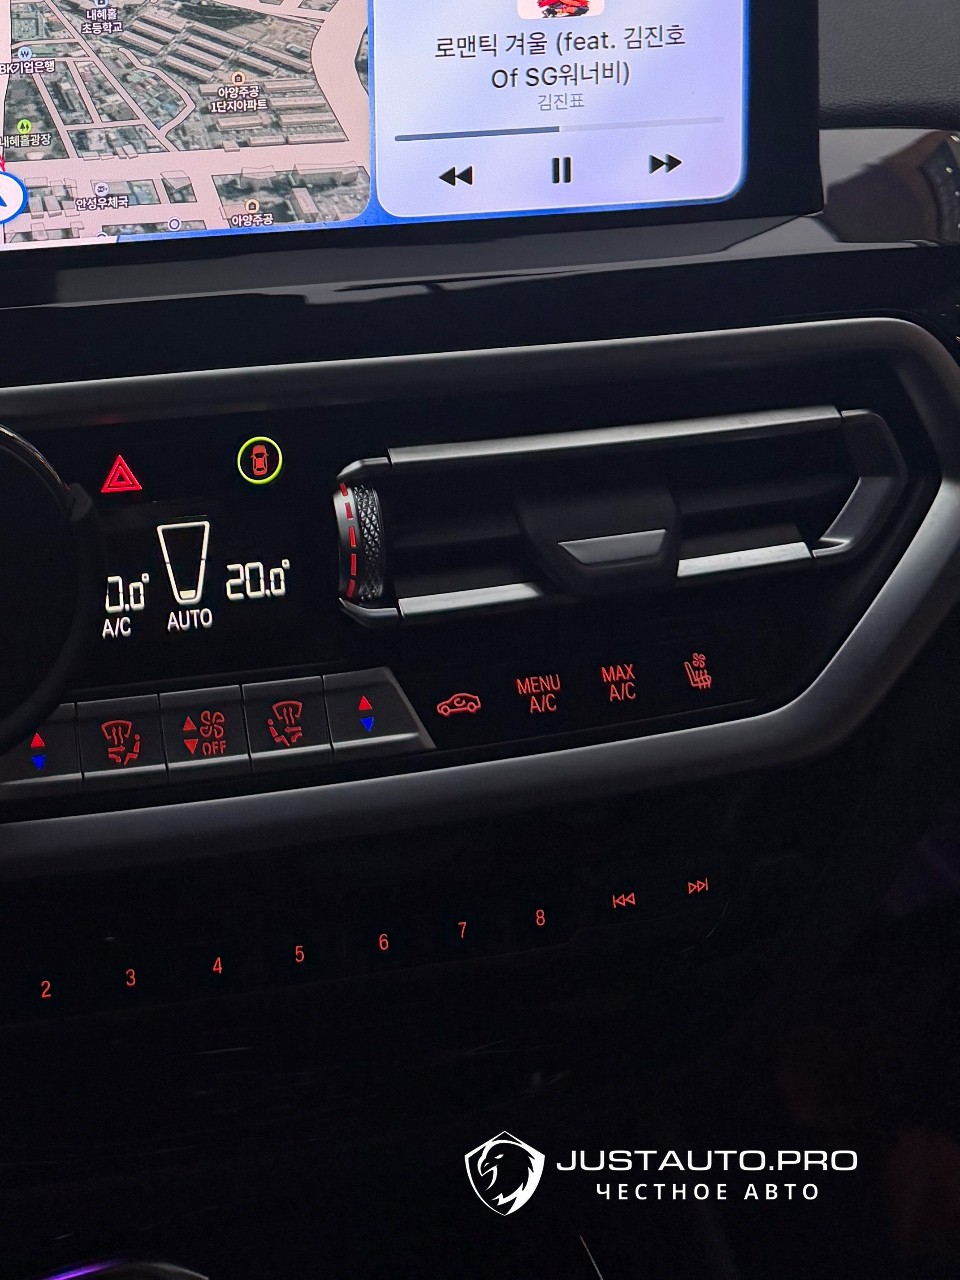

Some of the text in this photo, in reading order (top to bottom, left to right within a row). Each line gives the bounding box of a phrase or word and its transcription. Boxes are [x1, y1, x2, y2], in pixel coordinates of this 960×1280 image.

[82, 22, 123, 34] 초등학교
[435, 24, 686, 58] 로맨틱 겨울 (feat. 김진호
[491, 61, 631, 88] Of SG워너비)
[218, 85, 260, 98] 아양주공
[211, 99, 268, 113] 1단지아파트
[537, 93, 585, 111] 김진표
[75, 196, 129, 211] 안성우체국
[231, 213, 274, 227] 아양주공
[102, 617, 132, 639] A/C
[167, 608, 213, 632] AUTO
[601, 663, 636, 683] MAX
[516, 674, 561, 695] MENU
[609, 682, 637, 702] A/C
[530, 694, 557, 714] A/C
[201, 740, 227, 756] OFF
[41, 980, 52, 998] 2
[125, 969, 136, 987] 3
[212, 956, 223, 974] 4
[294, 945, 305, 962] 5
[378, 933, 389, 951] 6
[457, 921, 467, 938] 7
[535, 909, 545, 926] 8
